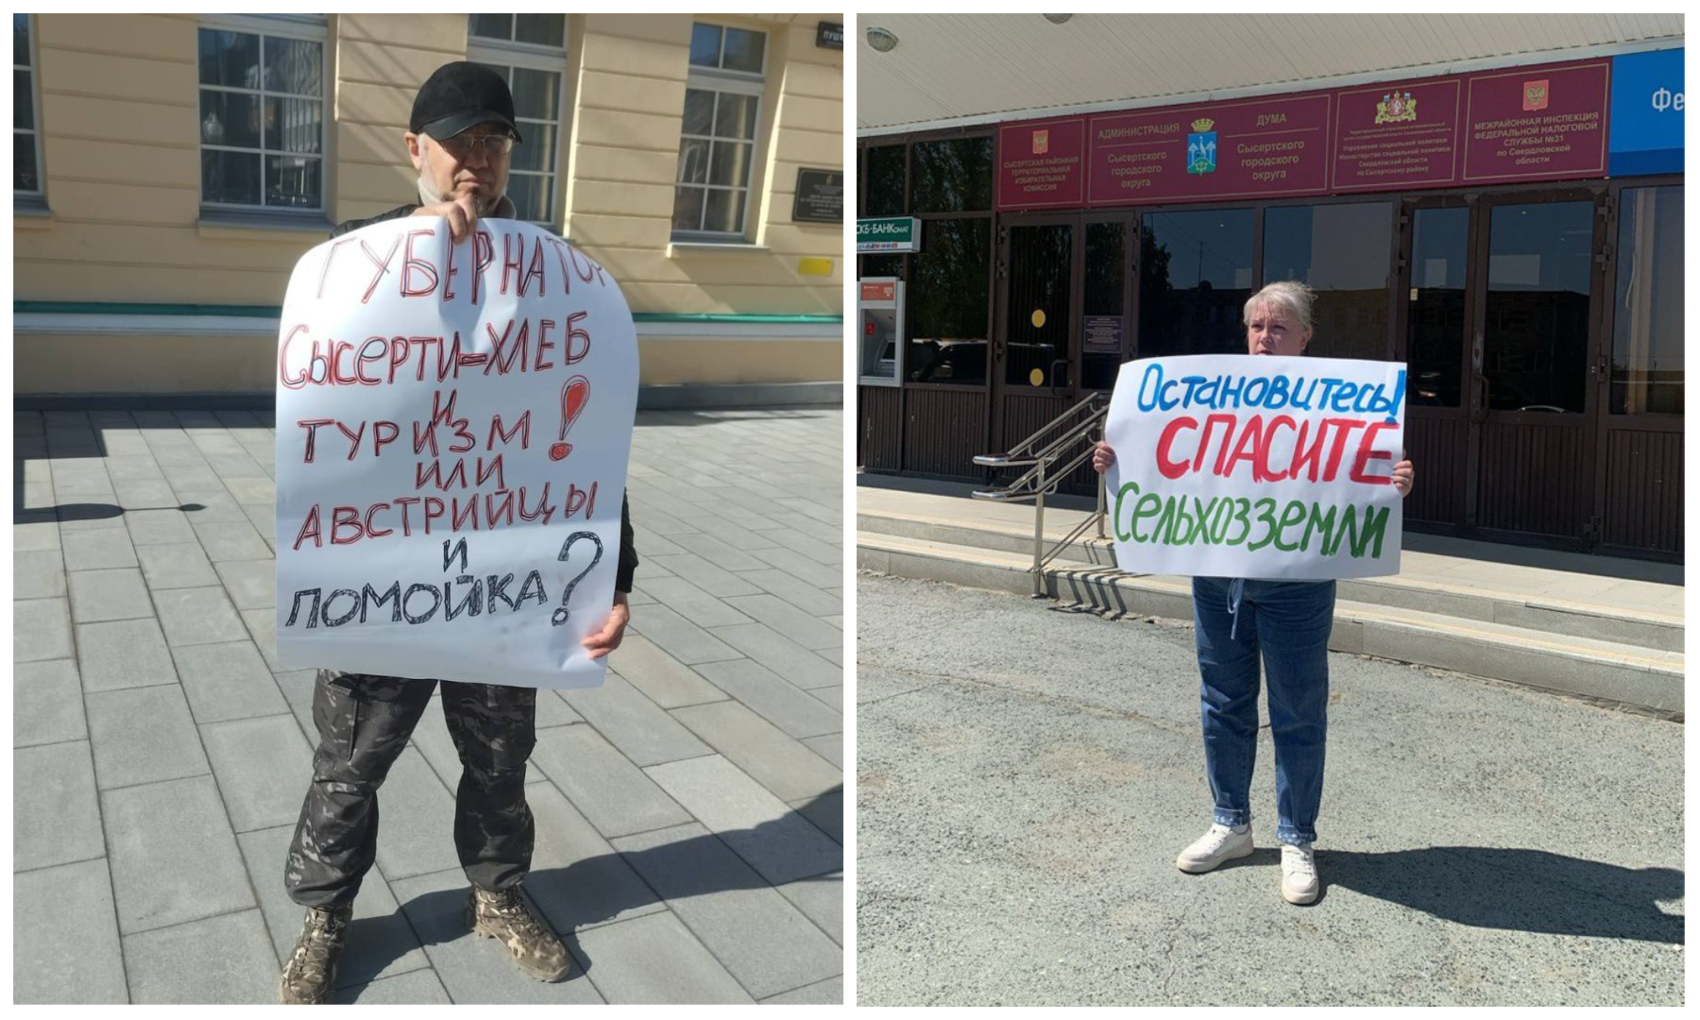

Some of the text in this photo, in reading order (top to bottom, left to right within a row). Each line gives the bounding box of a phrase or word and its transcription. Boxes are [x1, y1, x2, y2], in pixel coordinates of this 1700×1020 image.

[1256, 113, 1287, 127] ДУМА
[1474, 112, 1599, 131] МЕЖРАЙОННАЯ ИНСПЕКЦИЯ
[1098, 122, 1180, 140] АДМИНИСТРАЦИЯ
[1474, 121, 1598, 140] ФЕДЕРАЛЬНОЙ НАЛОГОВОЙ
[1237, 139, 1305, 154] Сысертского
[1503, 134, 1564, 147] СЛУЖБЫ №31
[1107, 150, 1167, 164] Сысертского
[1497, 144, 1571, 158] по Свердловской
[1241, 154, 1299, 169] городского
[1515, 156, 1550, 165] области
[1111, 164, 1162, 177] городского
[1252, 169, 1287, 182] округа
[1121, 178, 1151, 189] округа
[1137, 363, 1407, 425] Остановитесь!
[432, 389, 457, 427] И
[1156, 414, 1400, 484] СПАСИТЕ
[415, 453, 509, 492] ИЛИ
[293, 481, 599, 551] АВСТРИЙЦЫ
[1114, 481, 1391, 559] Сельхозземли
[442, 536, 468, 574] И
